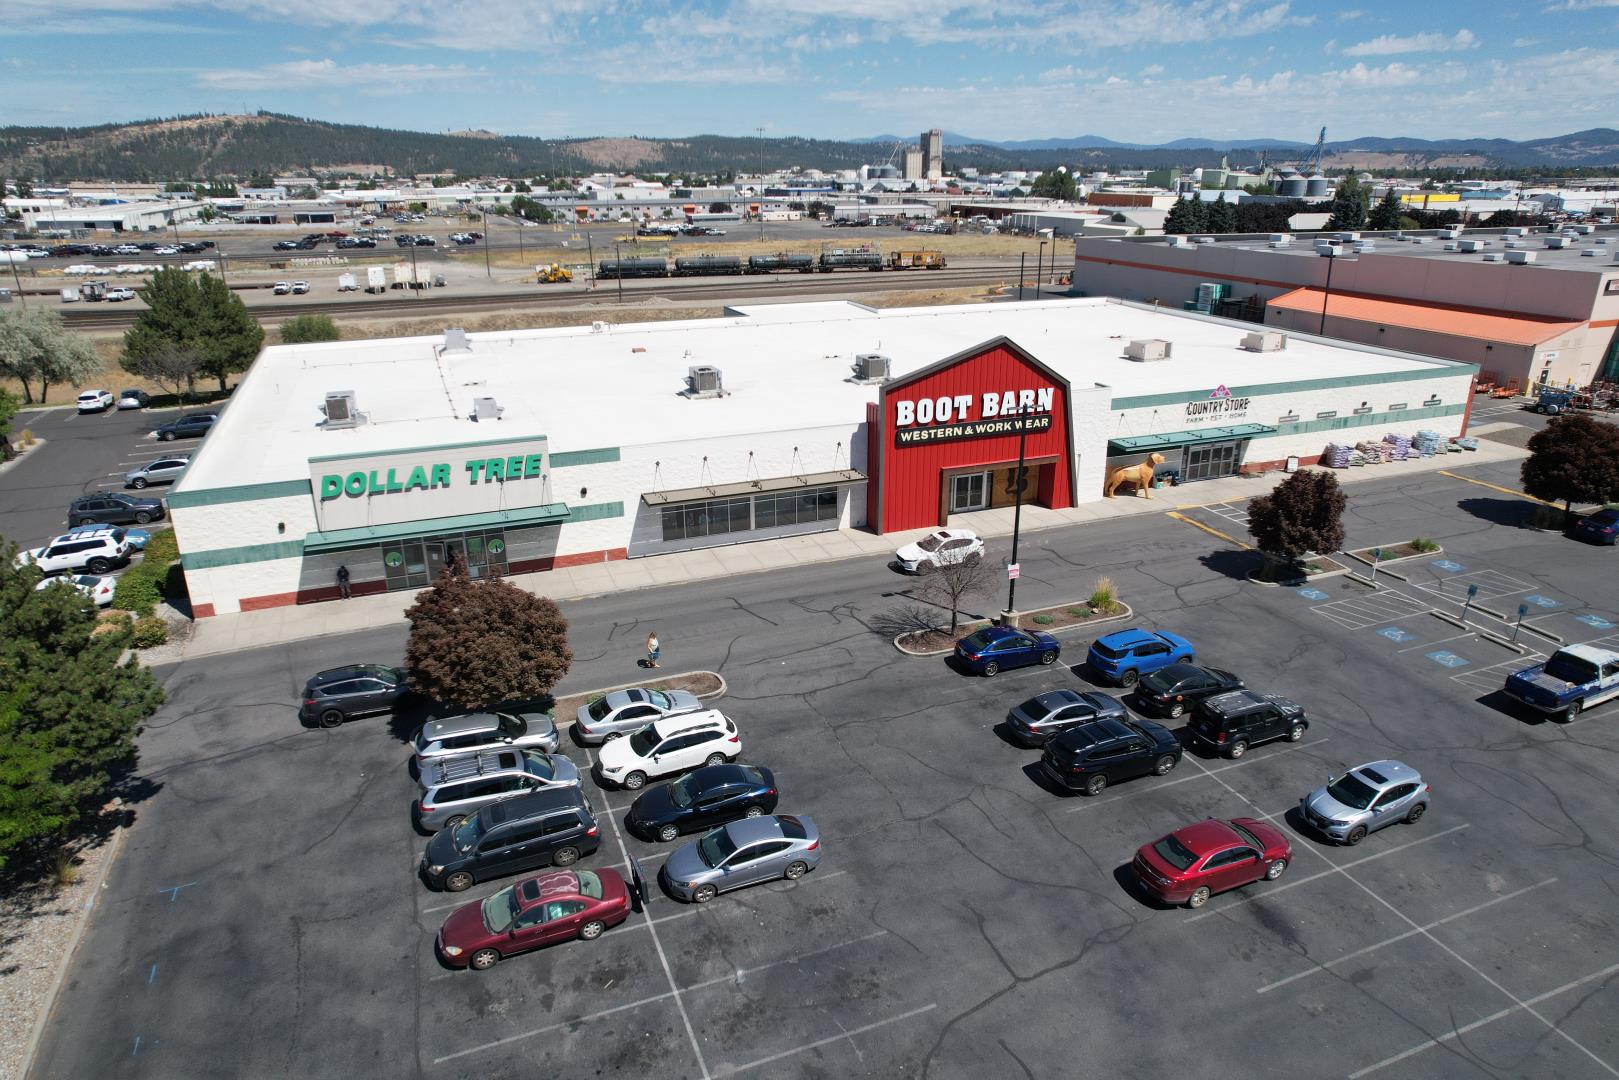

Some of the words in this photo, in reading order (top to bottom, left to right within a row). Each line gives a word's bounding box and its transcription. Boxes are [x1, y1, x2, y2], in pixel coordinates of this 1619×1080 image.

[896, 394, 973, 426] BOOT
[982, 387, 1055, 417] BARN
[1187, 401, 1224, 415] COUNTRY
[1225, 398, 1250, 411] STORE
[900, 428, 963, 442] WESTERN
[964, 425, 974, 435] &
[975, 421, 1012, 435] WORK
[1014, 417, 1049, 430] WEAR
[320, 463, 451, 501] DOLLAR
[466, 453, 542, 485] TREE
